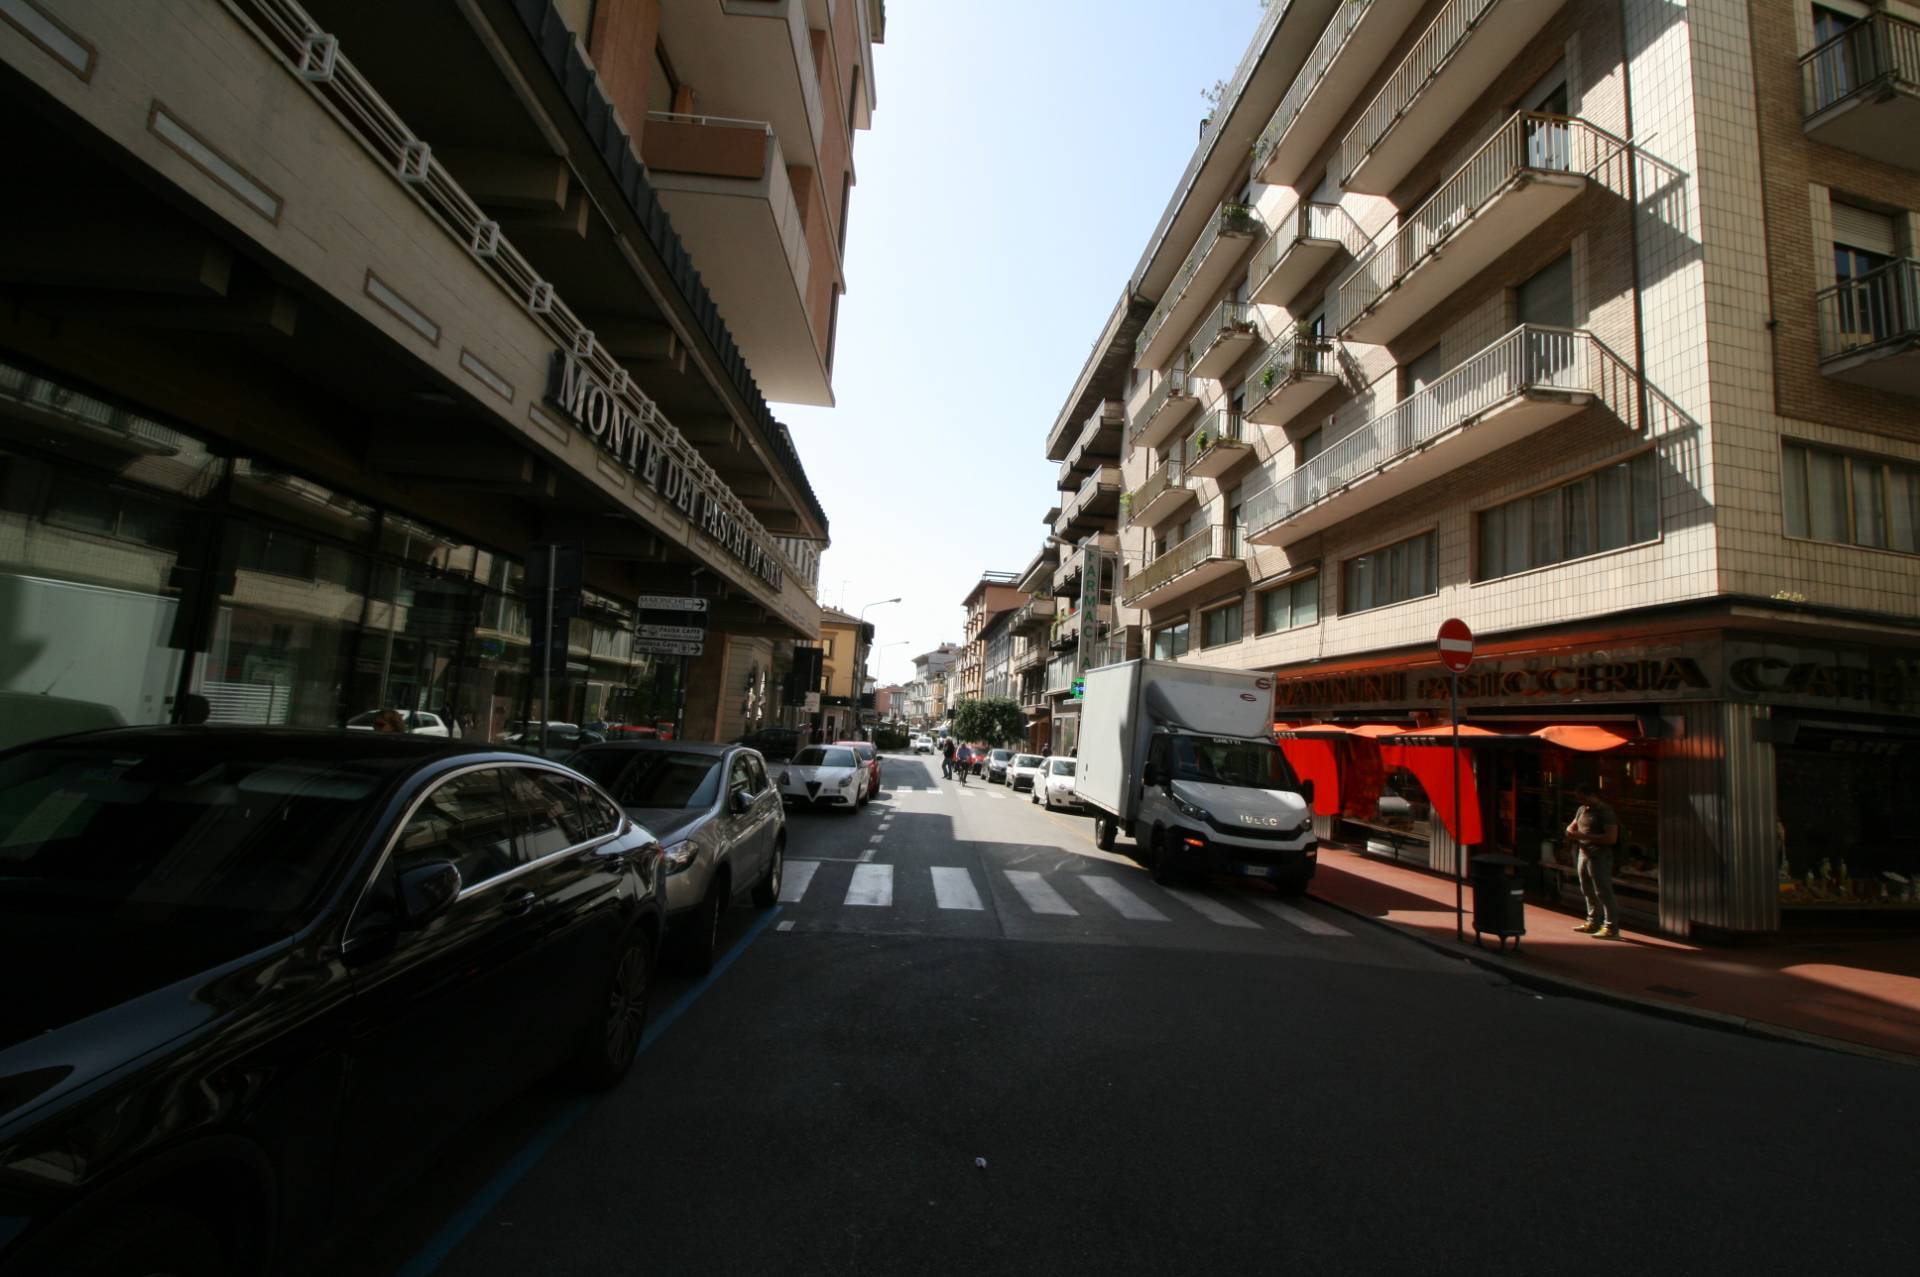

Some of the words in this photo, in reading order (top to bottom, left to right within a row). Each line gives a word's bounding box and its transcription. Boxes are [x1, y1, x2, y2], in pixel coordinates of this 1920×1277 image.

[558, 352, 664, 489] MONTE
[664, 458, 699, 519] DEI
[702, 494, 748, 561] PASCHI
[748, 543, 761, 574] DI
[1081, 551, 1097, 668] FARMACIA
[1240, 814, 1278, 827] IVECO
